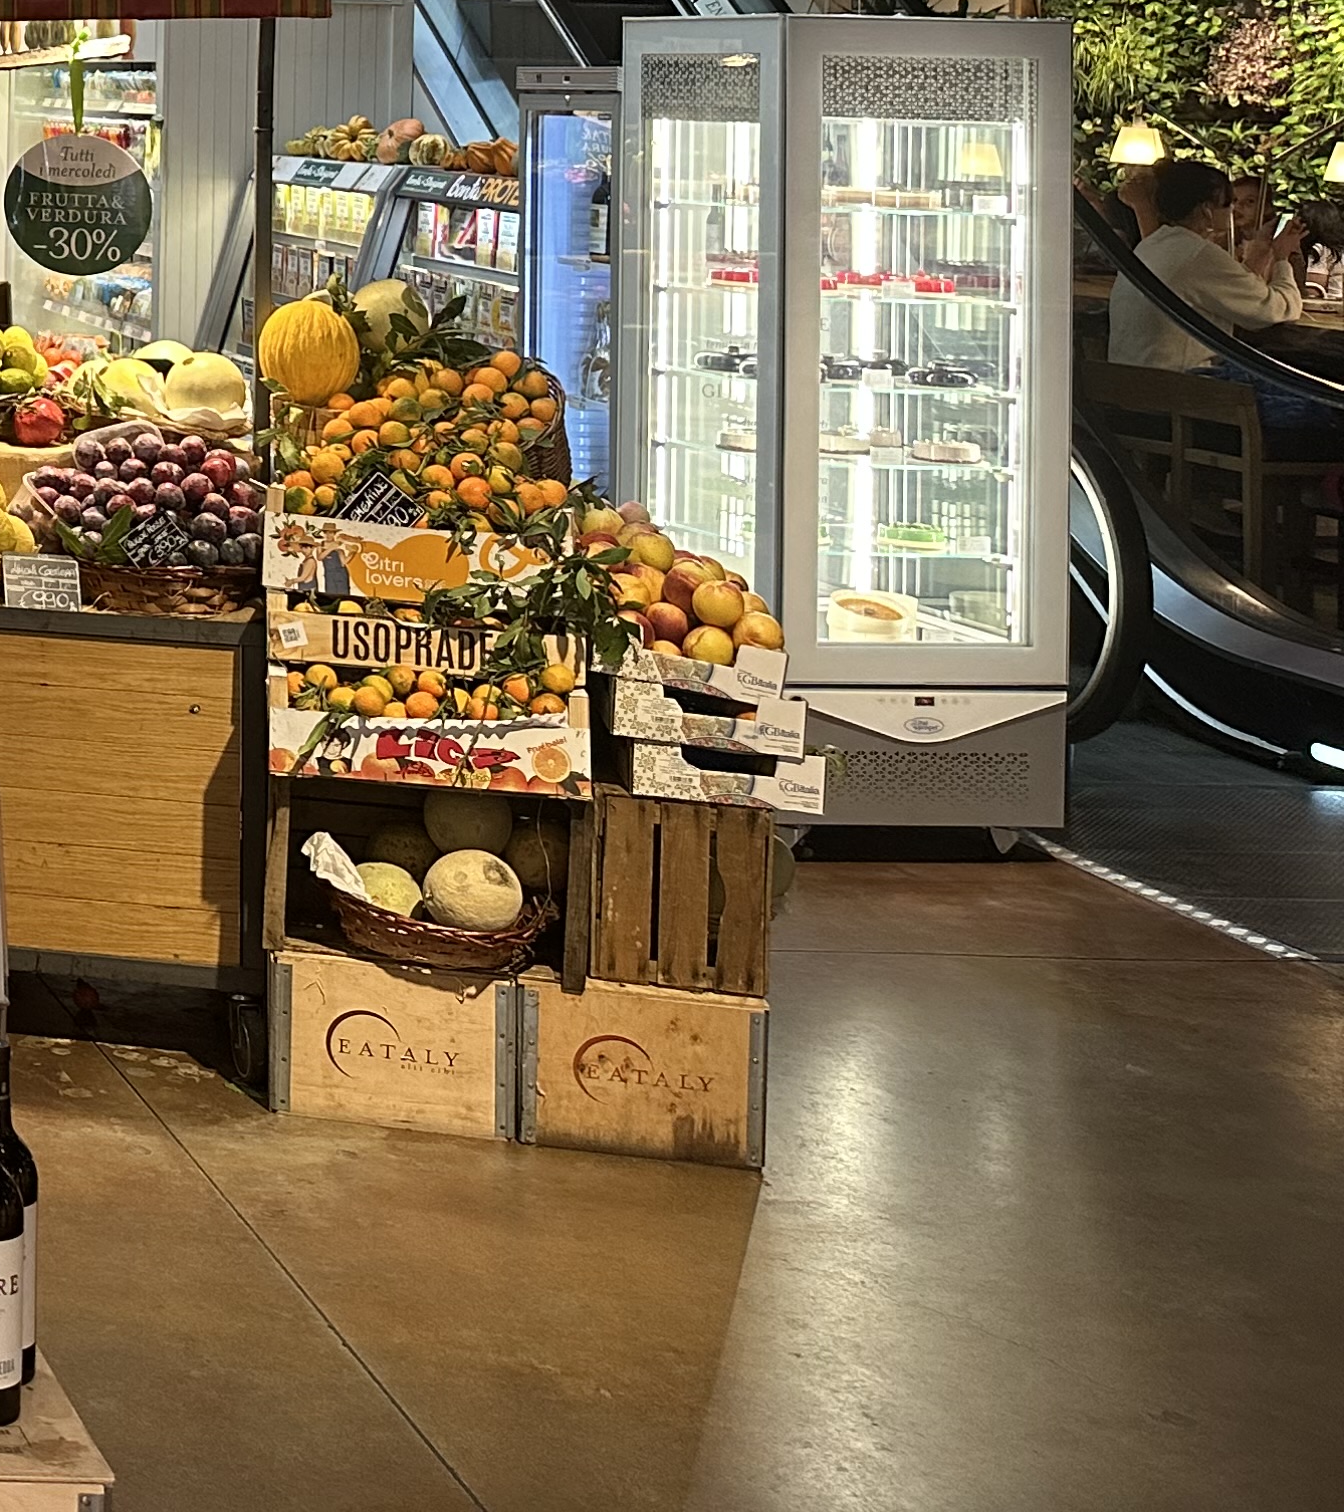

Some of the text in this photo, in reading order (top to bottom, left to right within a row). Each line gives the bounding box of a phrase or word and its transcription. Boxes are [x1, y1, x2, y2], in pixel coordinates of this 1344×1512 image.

[61, 146, 94, 162] Tutti
[48, 163, 116, 179] mercoledì
[29, 191, 126, 210] FRUTTA&
[25, 207, 127, 225] VERDURA
[33, 226, 121, 262] -30%
[365, 568, 423, 588] lovers
[338, 1037, 461, 1067] EATALY
[584, 1064, 715, 1092] EATALY
